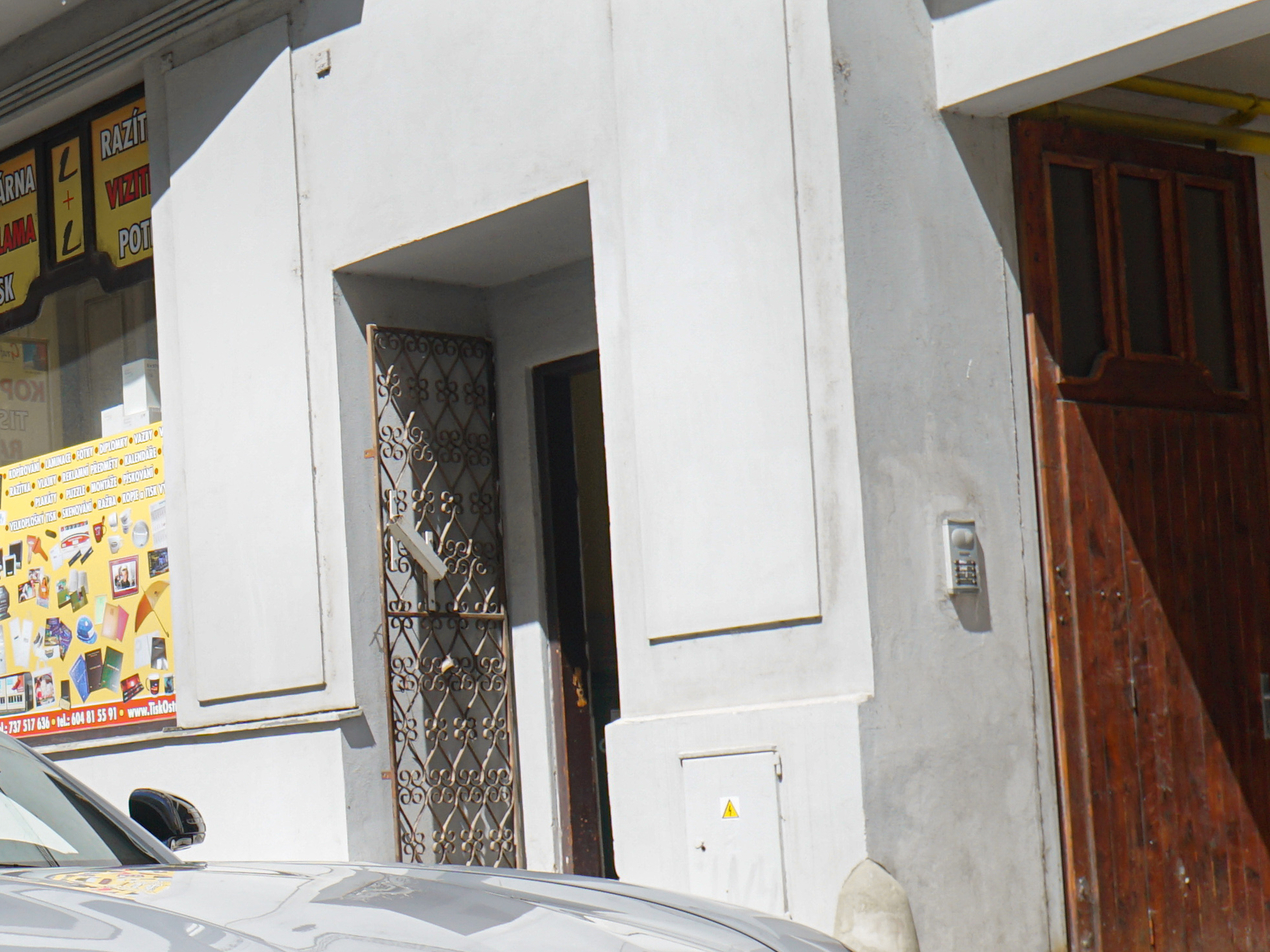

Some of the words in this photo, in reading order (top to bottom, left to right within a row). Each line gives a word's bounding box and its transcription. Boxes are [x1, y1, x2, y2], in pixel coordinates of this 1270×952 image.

[100, 107, 148, 161] RAZÍT
[105, 163, 151, 210] VIZIT
[118, 218, 153, 259] POT
[9, 720, 21, 734] 737
[23, 718, 35, 731] 517
[37, 716, 50, 731] 636
[57, 713, 70, 727] tel.:
[71, 711, 85, 726] 604
[86, 710, 95, 723] 81
[97, 708, 107, 722] 55
[108, 706, 118, 720] 91
